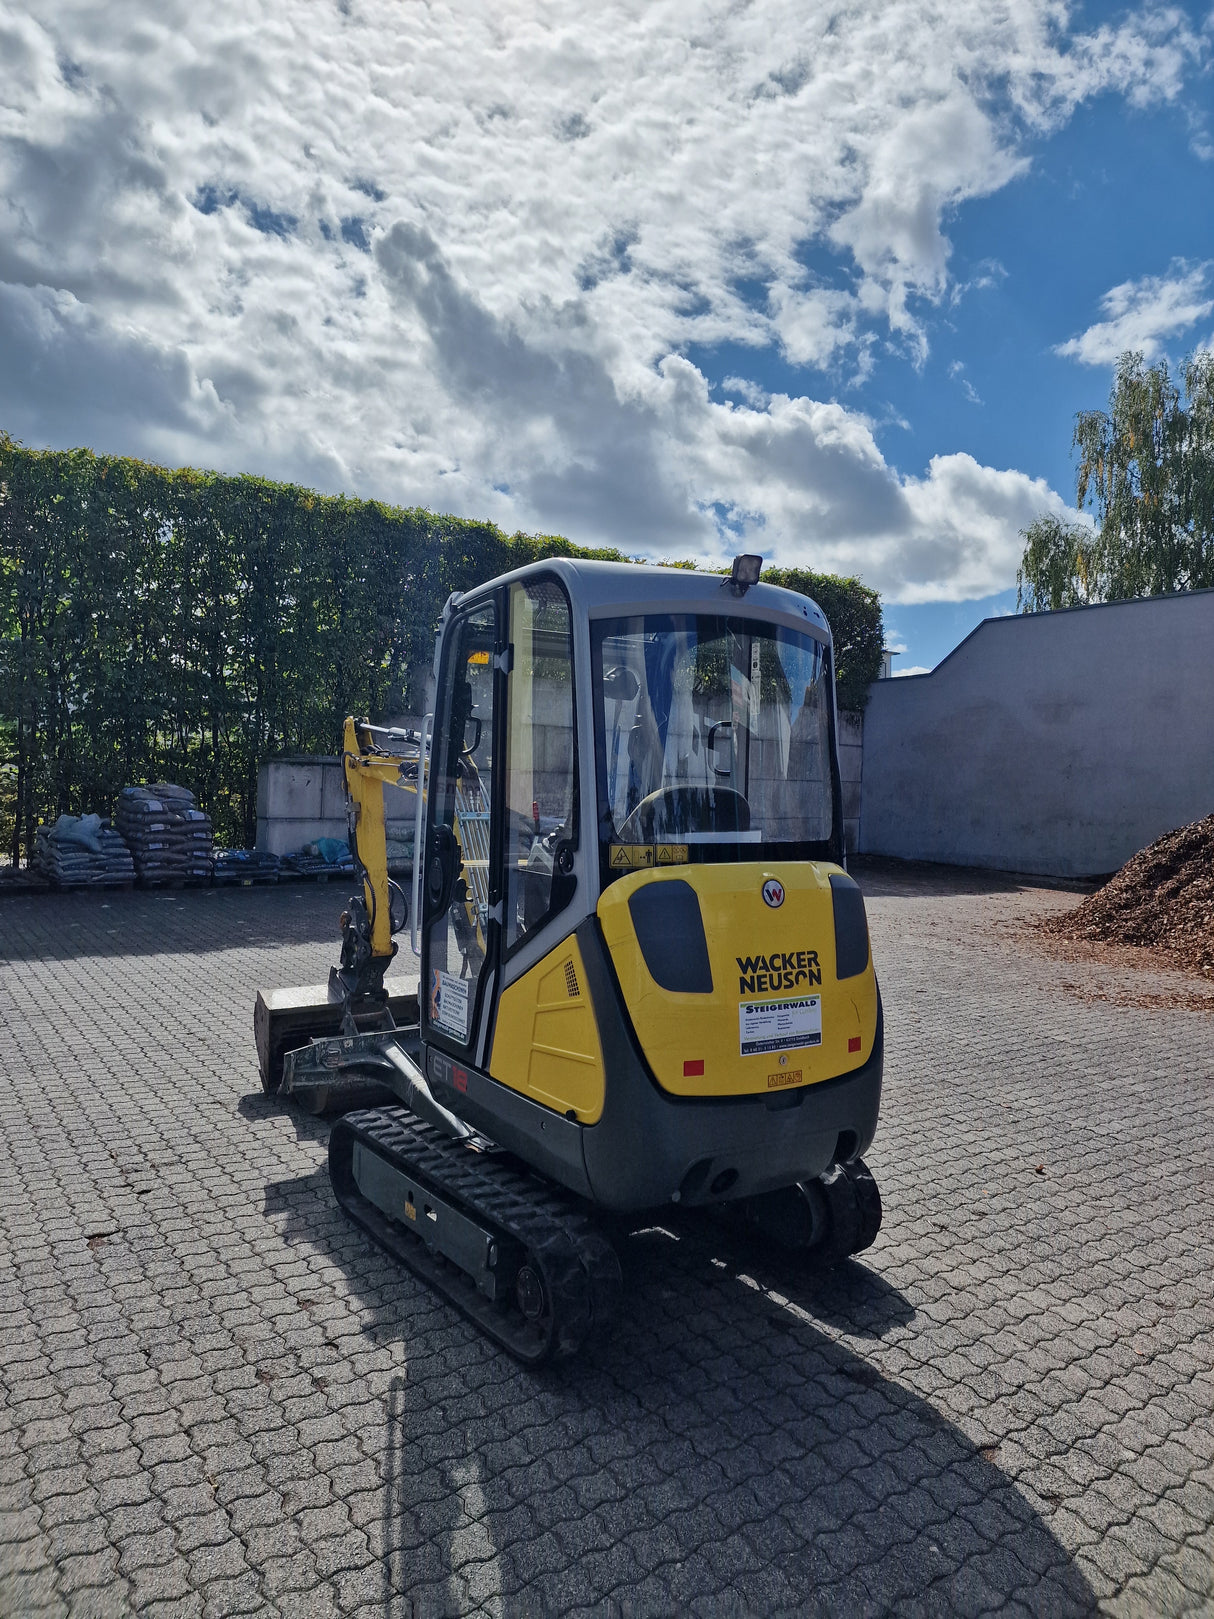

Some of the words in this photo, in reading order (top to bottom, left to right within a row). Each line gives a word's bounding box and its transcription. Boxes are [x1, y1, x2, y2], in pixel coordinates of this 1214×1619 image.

[736, 950, 820, 975] WACKER
[739, 968, 822, 994] NEUSON
[745, 1000, 817, 1014] STEIGERWALD
